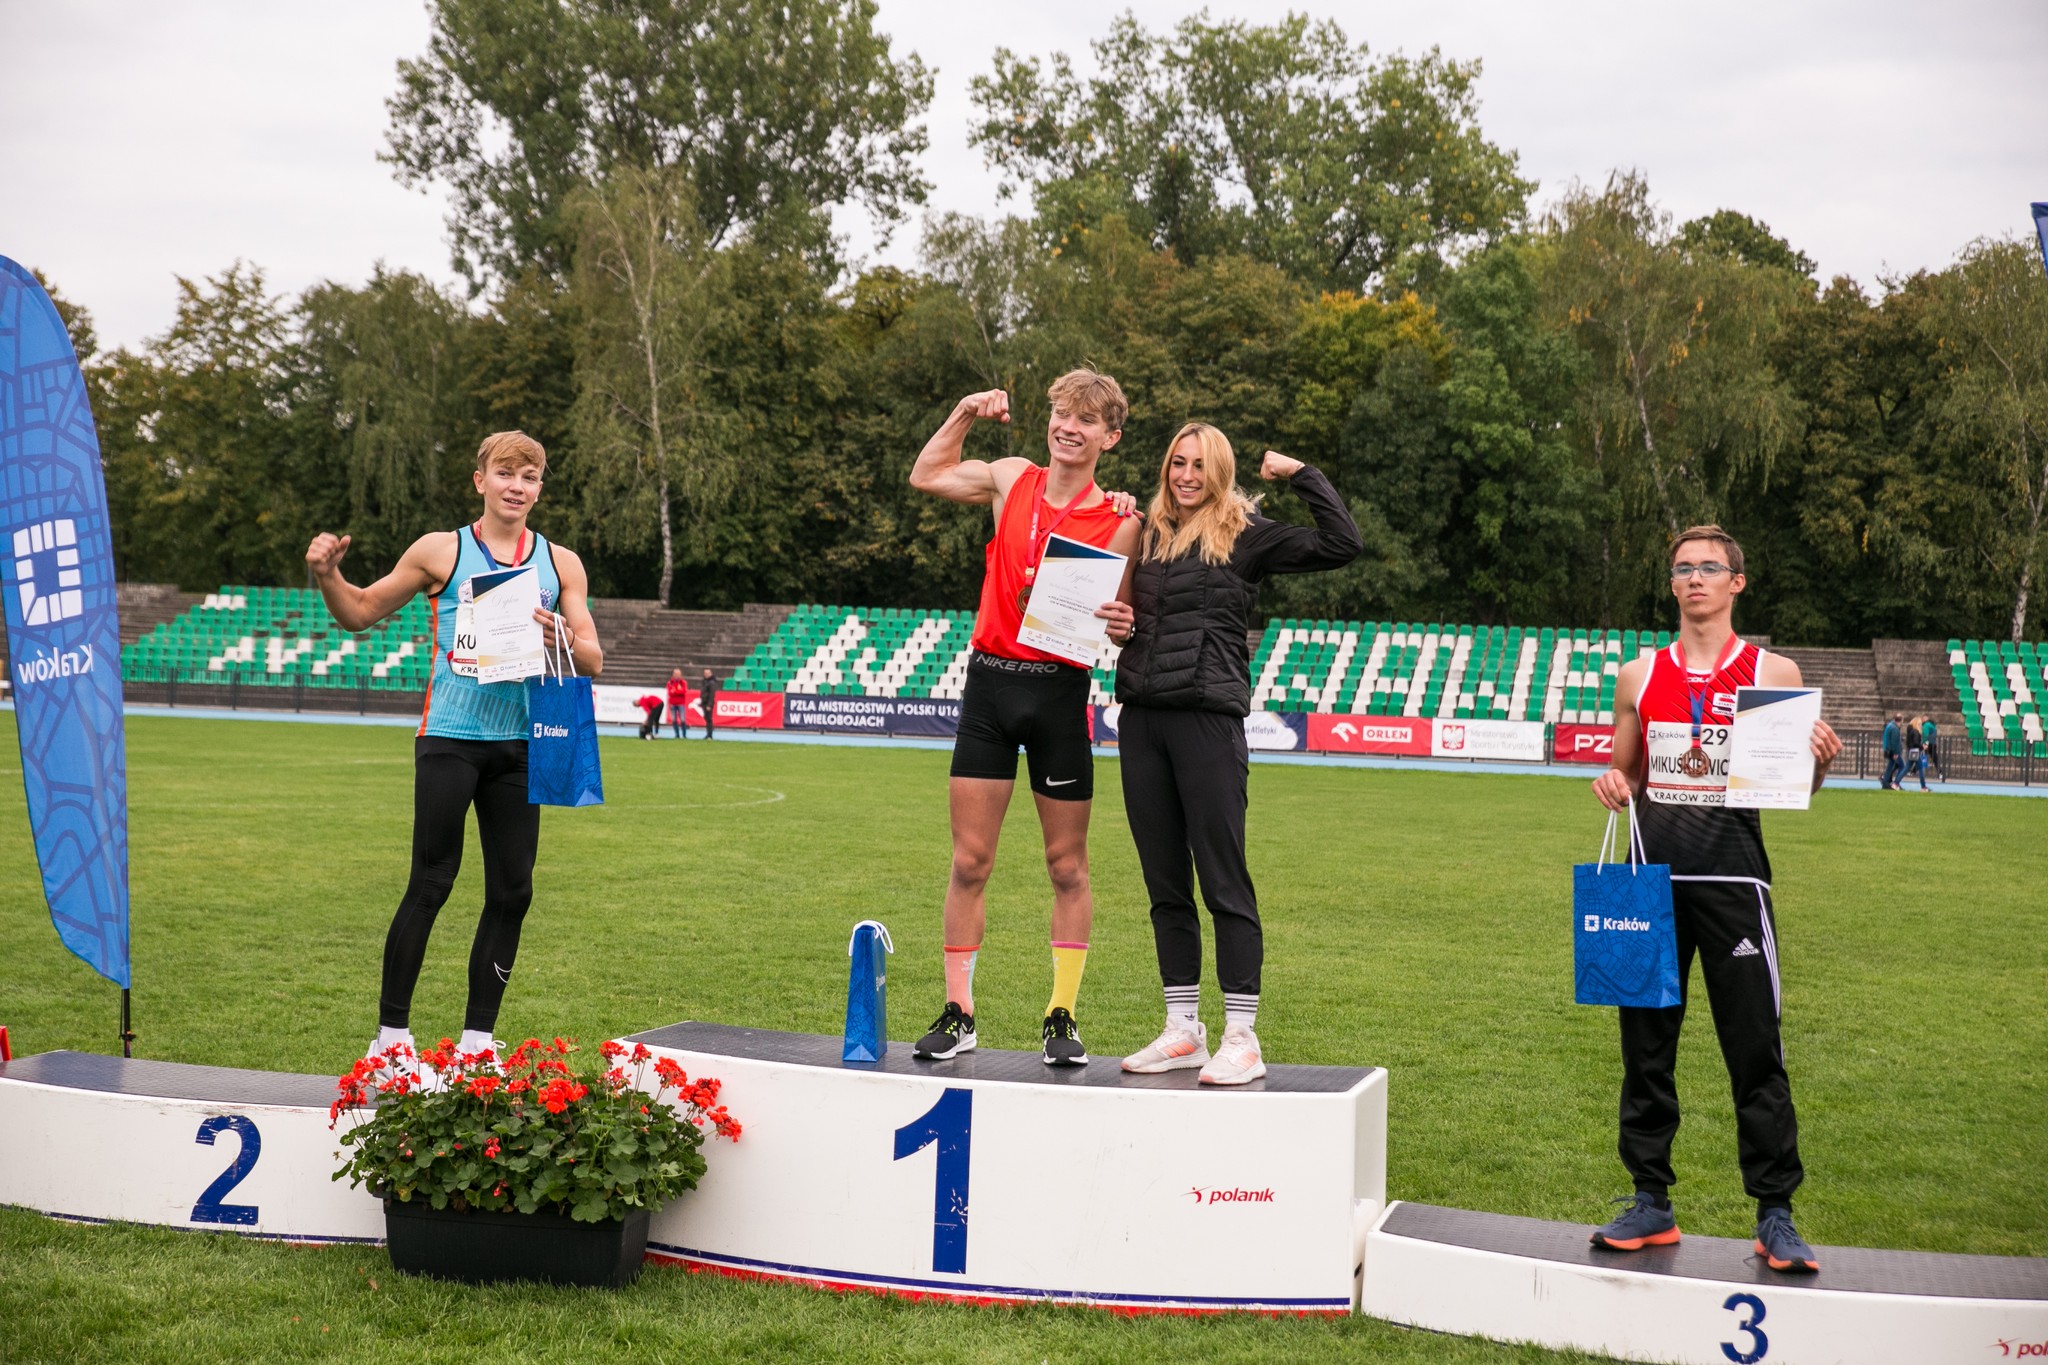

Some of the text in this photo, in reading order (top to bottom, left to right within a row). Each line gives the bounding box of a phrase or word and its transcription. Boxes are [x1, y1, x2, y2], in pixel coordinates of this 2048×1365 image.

[976, 654, 1058, 674] NIKE PRO
[720, 703, 758, 714] ORLEN
[790, 700, 960, 718] PZLA MISTRZOSTWA POLSKI U16
[789, 713, 885, 727] W WIELOBOJACH
[543, 725, 569, 738] Kraków
[1251, 726, 1277, 736] Atletyki
[1366, 728, 1411, 740] ORLEN
[1657, 731, 1686, 740] Kraków
[1701, 728, 1729, 746] 29
[1654, 790, 1698, 802] KRAKÓW
[1603, 917, 1650, 932] Kraków
[1732, 948, 1760, 957] adidas
[190, 1115, 262, 1226] 2
[893, 1087, 973, 1275] 1
[1209, 1187, 1275, 1205] polanik
[1719, 1292, 1769, 1365] 3
